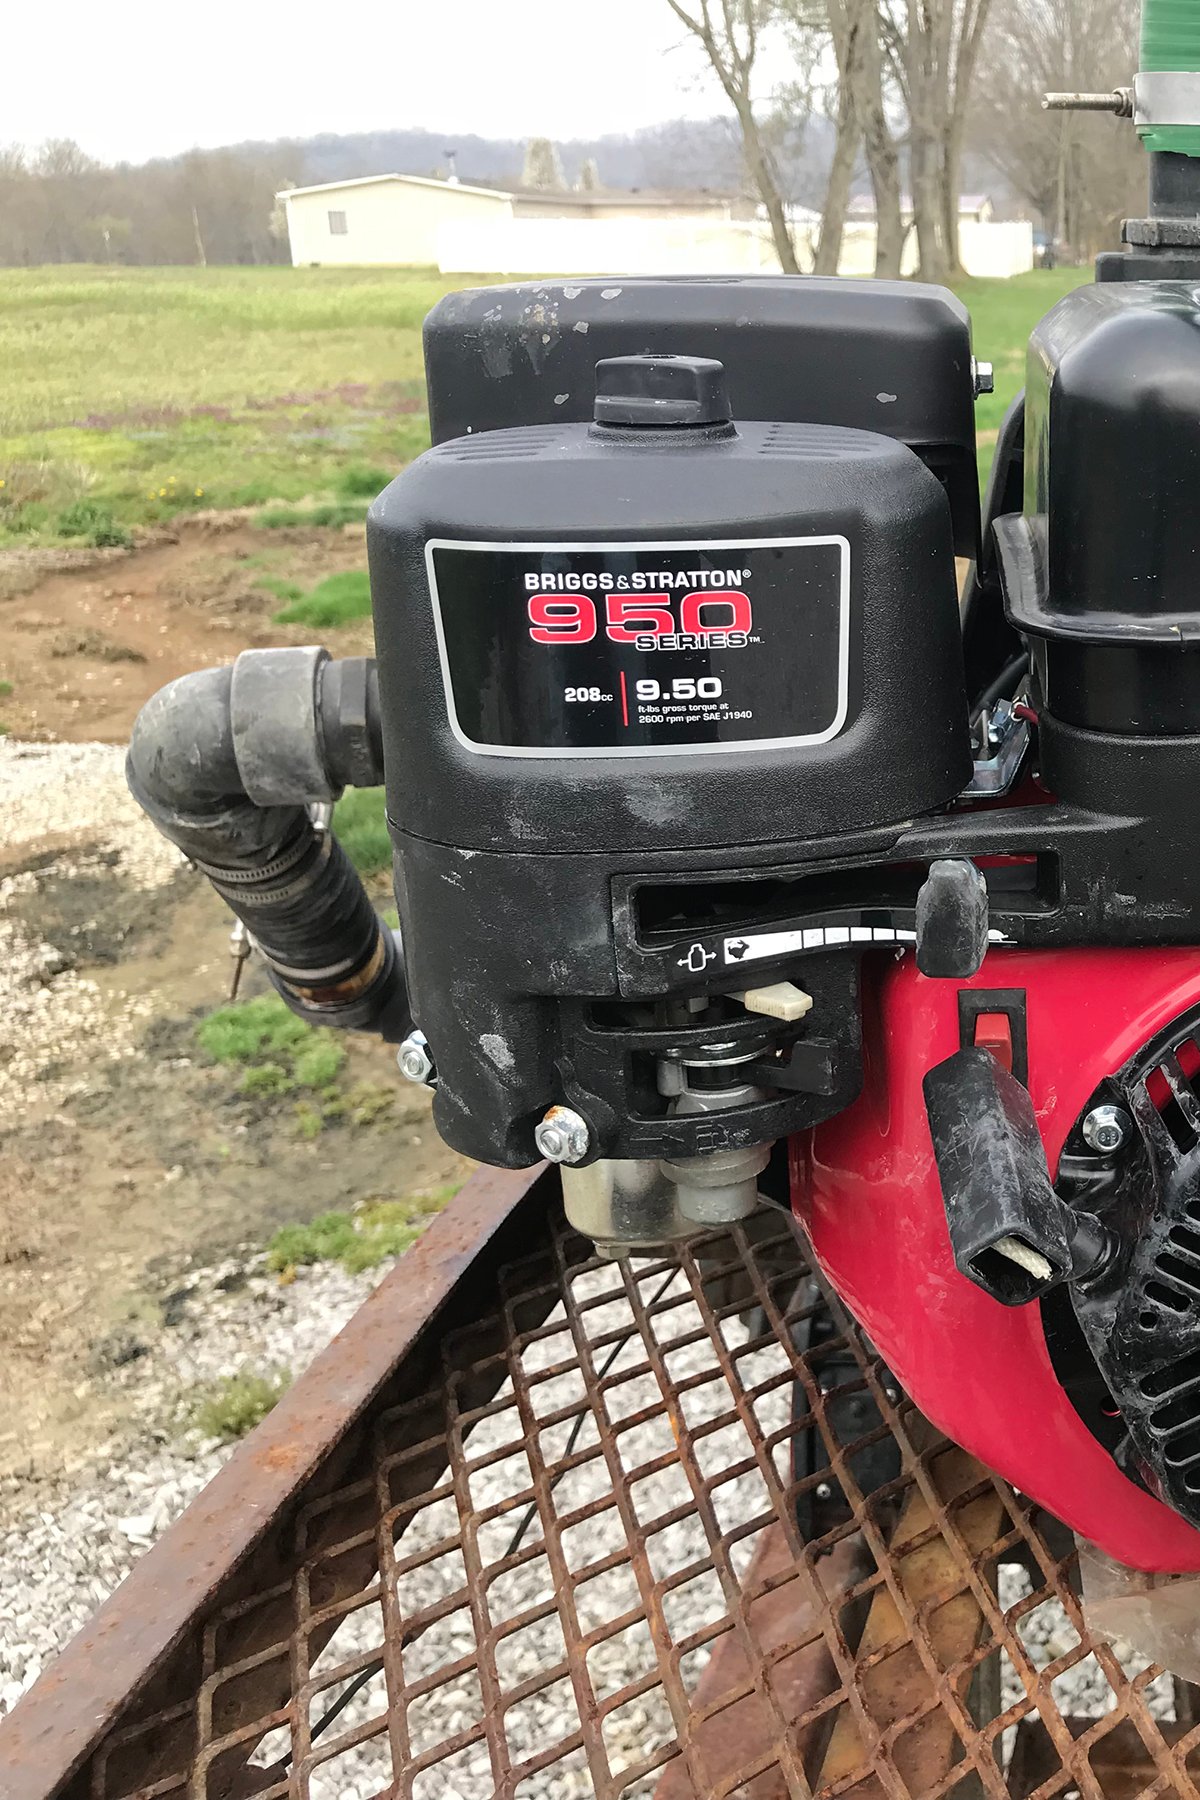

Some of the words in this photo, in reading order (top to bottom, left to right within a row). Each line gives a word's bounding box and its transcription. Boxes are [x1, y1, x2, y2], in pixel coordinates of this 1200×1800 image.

[527, 590, 752, 644] 950
[564, 687, 613, 702] 208cc
[635, 677, 722, 701] 9.50
[639, 715, 664, 723] 2600
[666, 716, 684, 725] rpm
[686, 714, 701, 723] per
[703, 712, 721, 720] SAE
[723, 711, 752, 720] J1940
[662, 706, 687, 715] gross
[689, 703, 717, 713] torque
